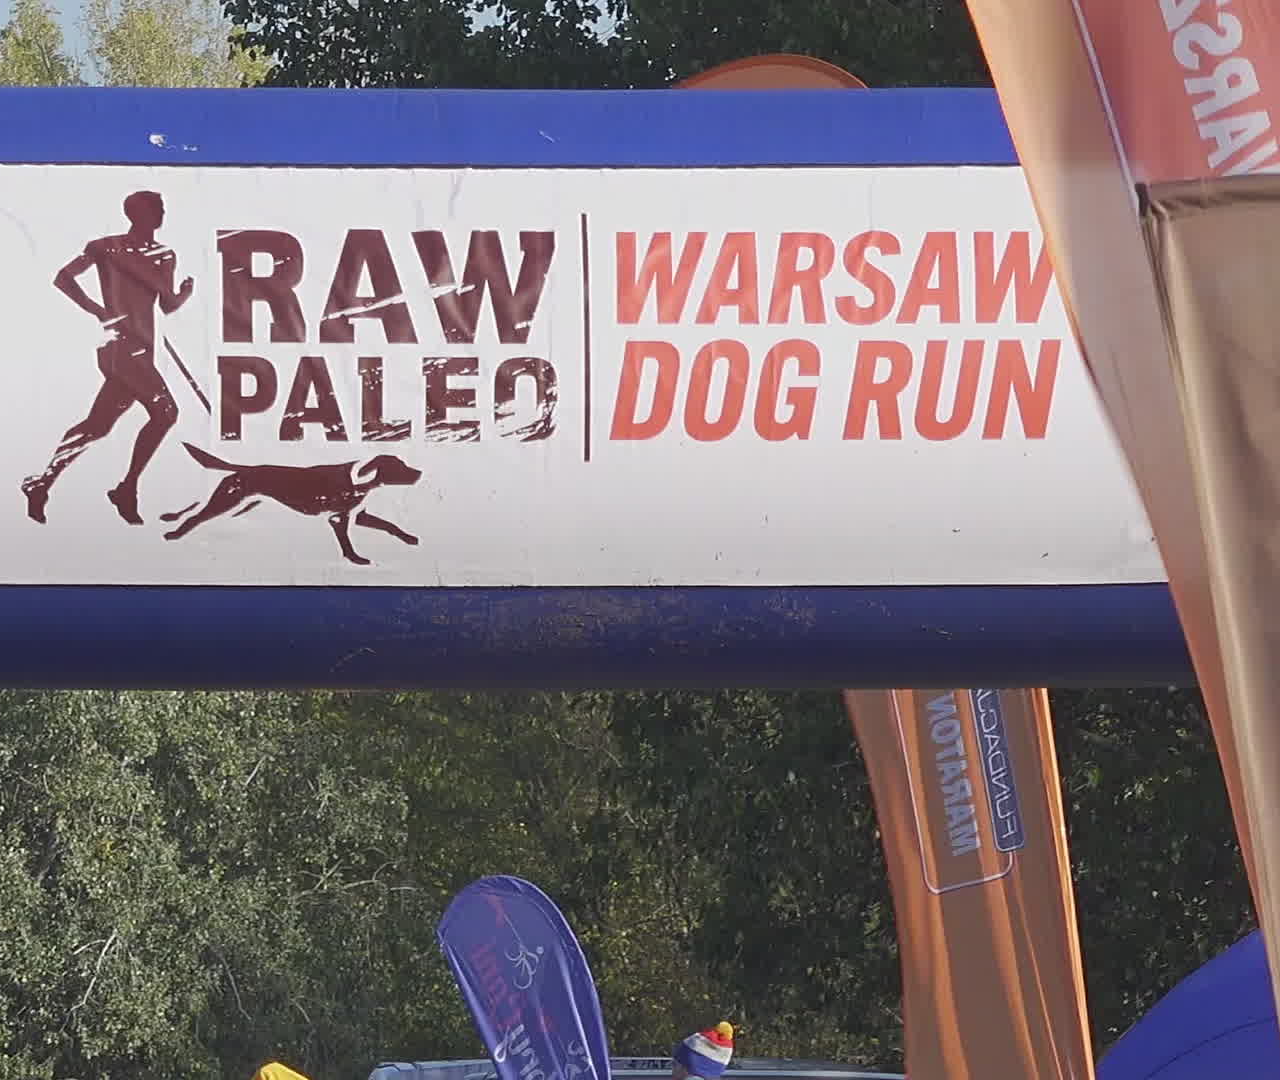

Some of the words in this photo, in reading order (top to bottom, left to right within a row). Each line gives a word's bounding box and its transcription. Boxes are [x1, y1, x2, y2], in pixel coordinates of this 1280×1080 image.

[216, 228, 557, 344] RAW
[614, 230, 1055, 326] WARSAW
[216, 355, 559, 443] PALEO
[608, 339, 822, 442] DOG
[841, 339, 1061, 442] RUN
